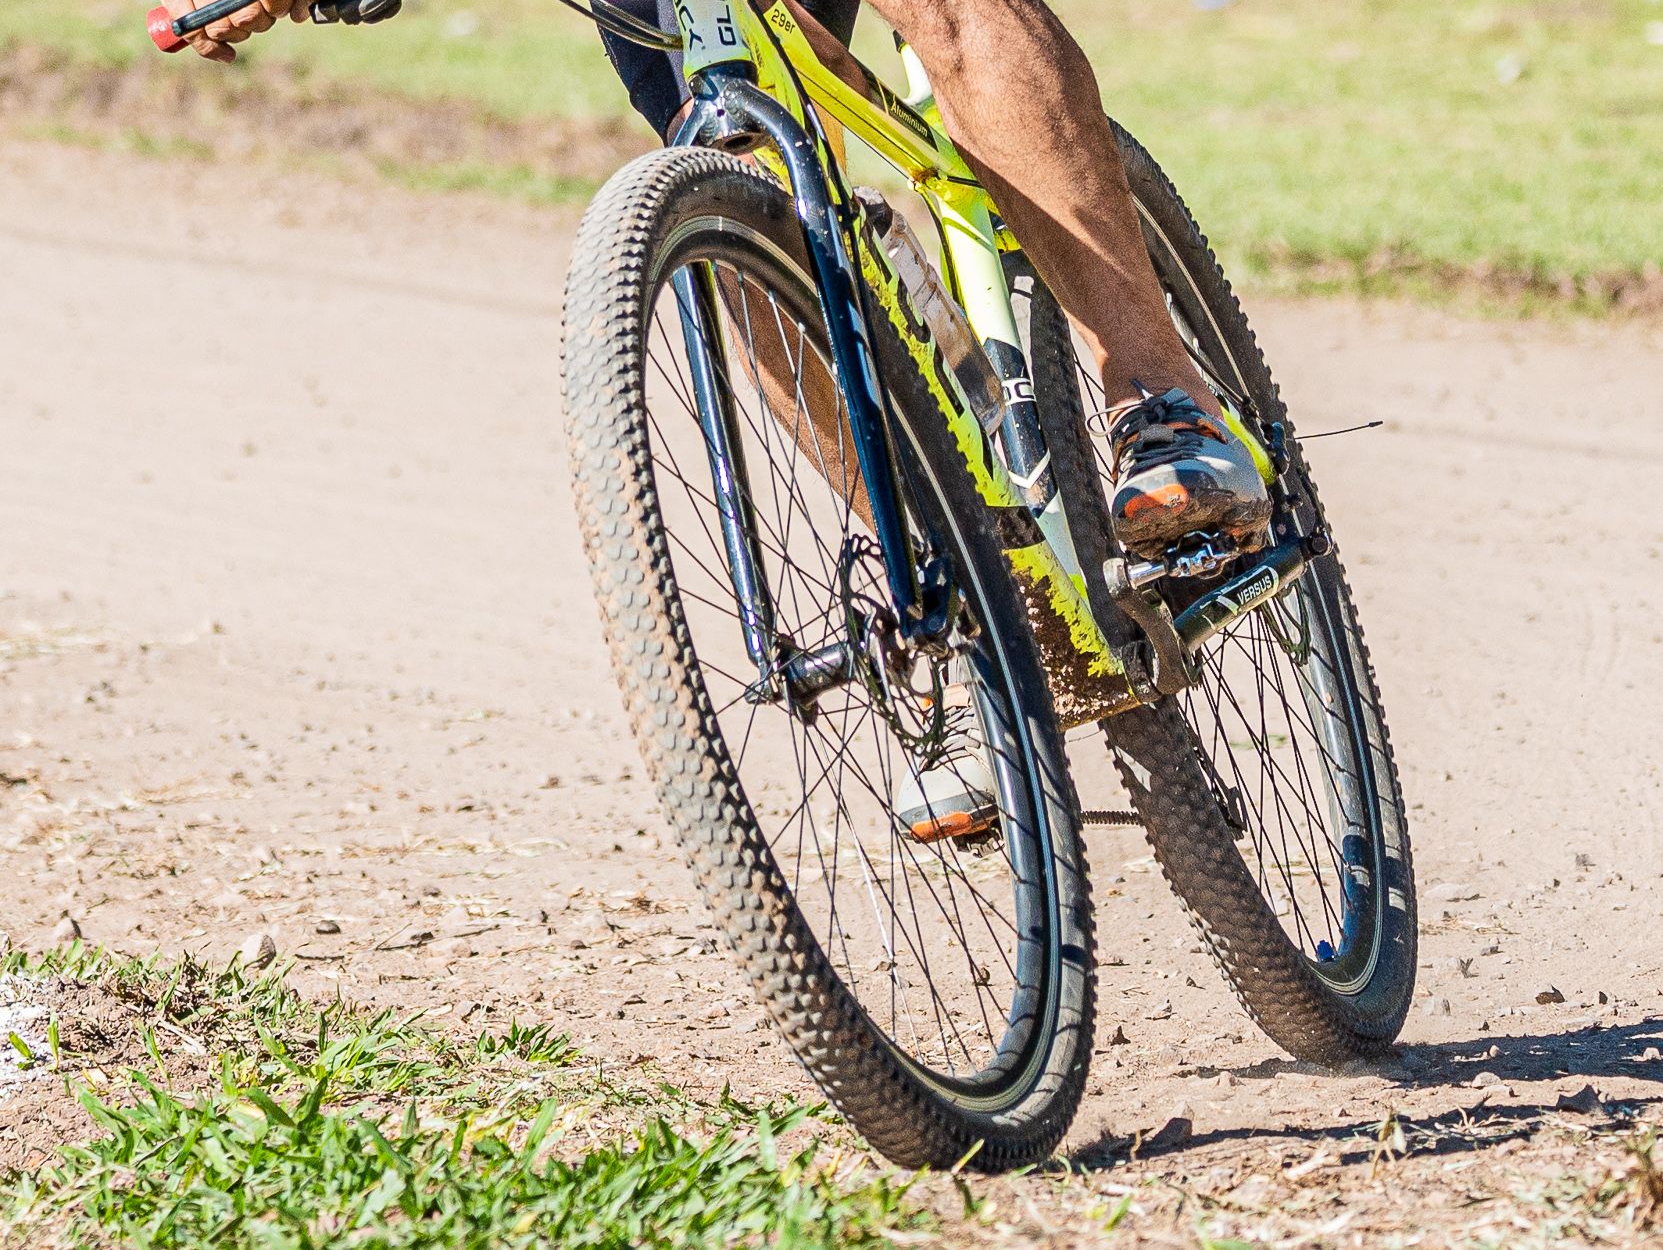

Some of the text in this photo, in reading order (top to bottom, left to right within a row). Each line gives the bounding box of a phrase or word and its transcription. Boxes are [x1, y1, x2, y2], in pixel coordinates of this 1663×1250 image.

[770, 8, 797, 35] 29er
[890, 94, 928, 137] Aluminium
[1237, 575, 1272, 606] VERSUS
